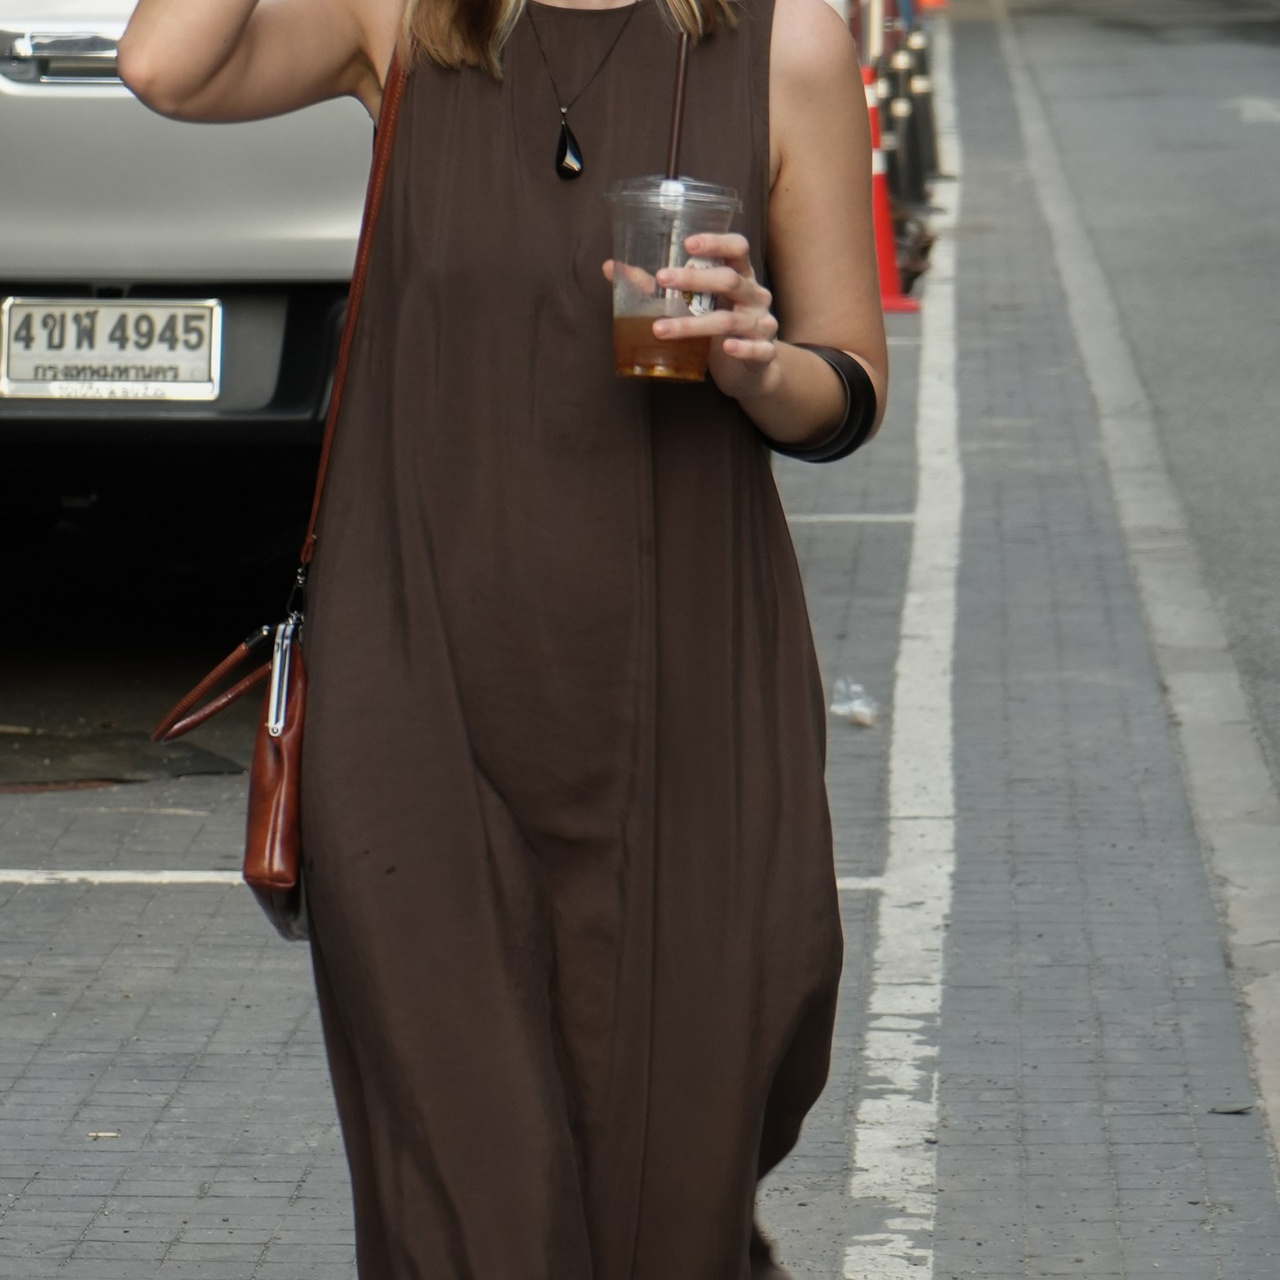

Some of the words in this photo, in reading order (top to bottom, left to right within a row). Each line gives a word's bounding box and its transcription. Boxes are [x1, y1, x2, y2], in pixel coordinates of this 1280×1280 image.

[108, 312, 206, 351] 4945
[33, 364, 179, 381] กรงเทพมหานคร
